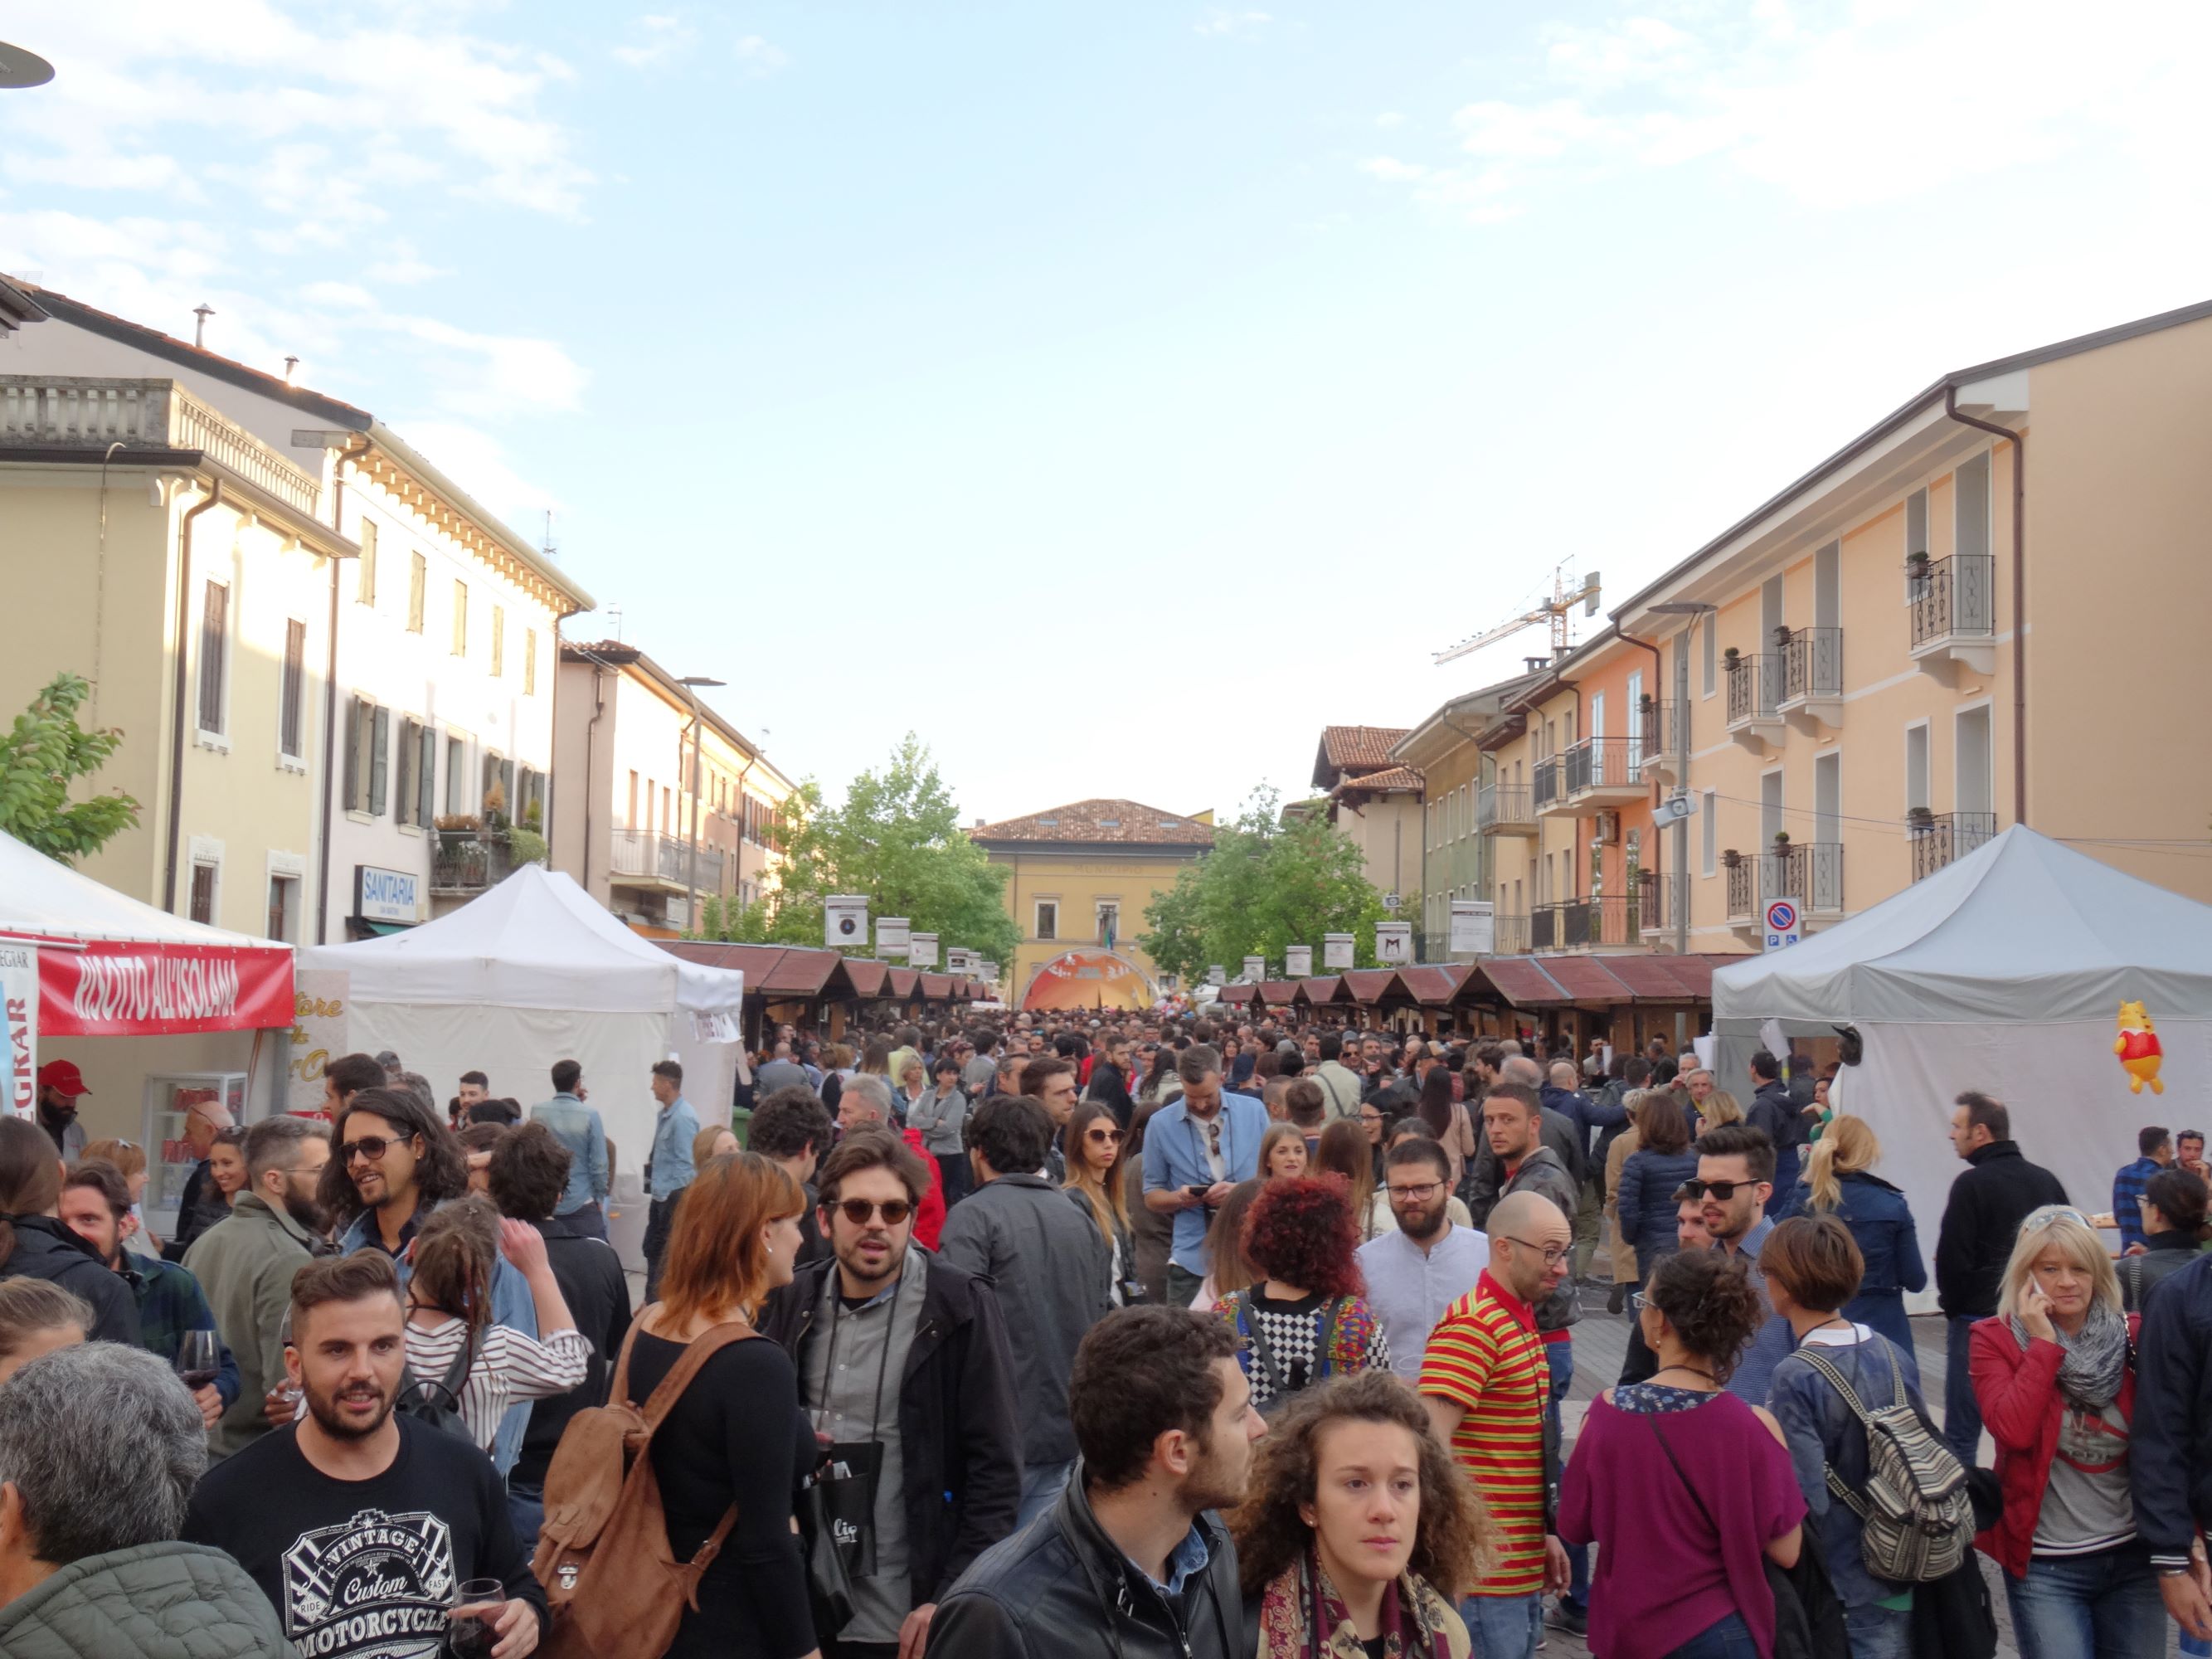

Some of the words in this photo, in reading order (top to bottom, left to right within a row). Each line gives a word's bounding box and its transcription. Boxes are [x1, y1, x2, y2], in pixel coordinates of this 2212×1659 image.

[365, 871, 415, 906] SANITARIA
[74, 956, 148, 1021] RISOTTO
[151, 956, 240, 1020] ALL'ISOLANA
[327, 1529, 420, 1564] VINTAGE
[344, 1574, 408, 1605] Custom
[429, 1579, 446, 1589] FAST
[300, 1600, 321, 1613] RIDE
[294, 1608, 450, 1658] MOTORCYCLE
